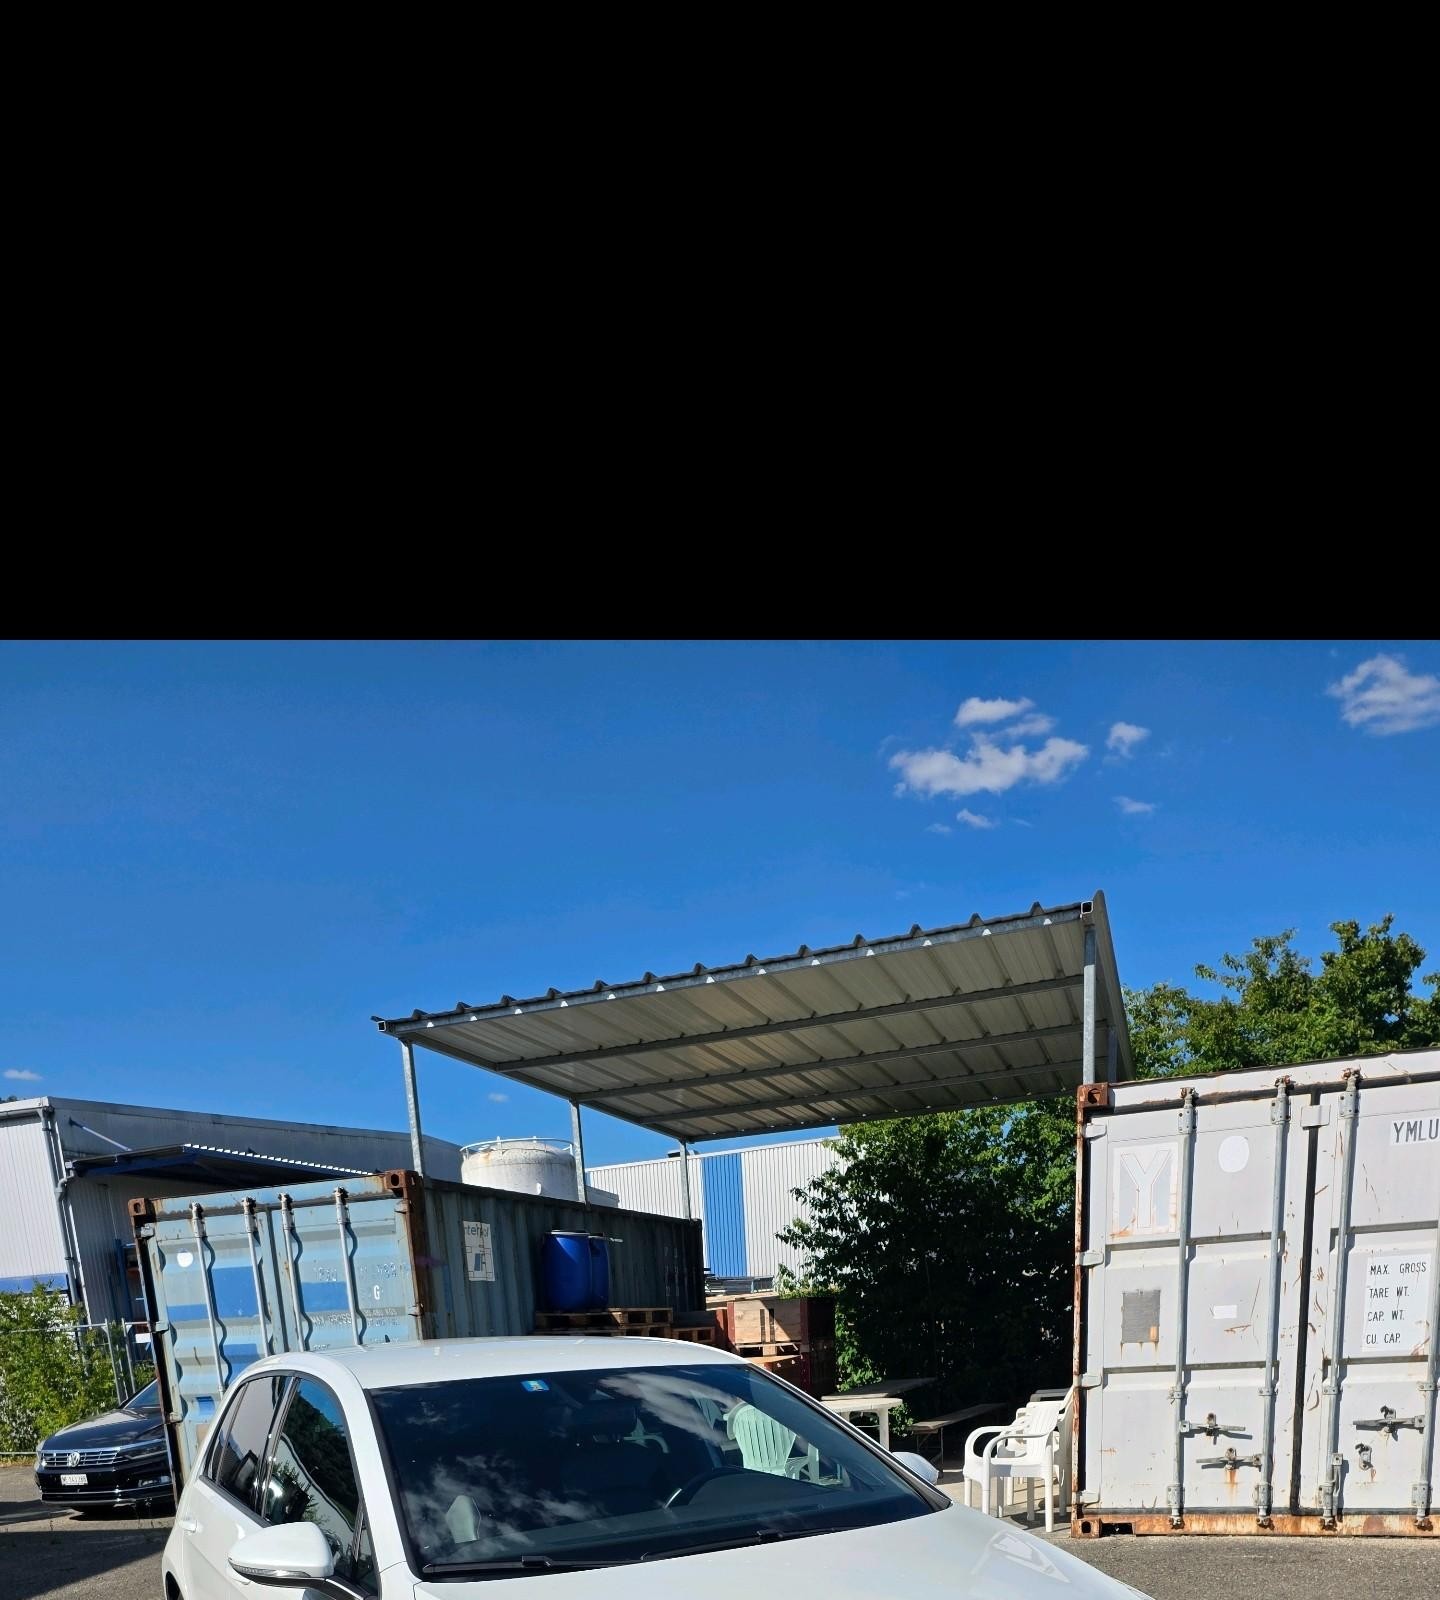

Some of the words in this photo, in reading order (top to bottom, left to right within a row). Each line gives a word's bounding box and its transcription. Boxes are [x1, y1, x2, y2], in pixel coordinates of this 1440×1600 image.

[1393, 1118, 1439, 1143] YMLU
[1399, 1262, 1427, 1274] GROSS
[373, 1285, 381, 1300] G
[1369, 1287, 1389, 1299] TARE
[1396, 1286, 1410, 1297] WT.
[1367, 1310, 1385, 1322] CAP.
[1384, 1332, 1401, 1344] CAP.
